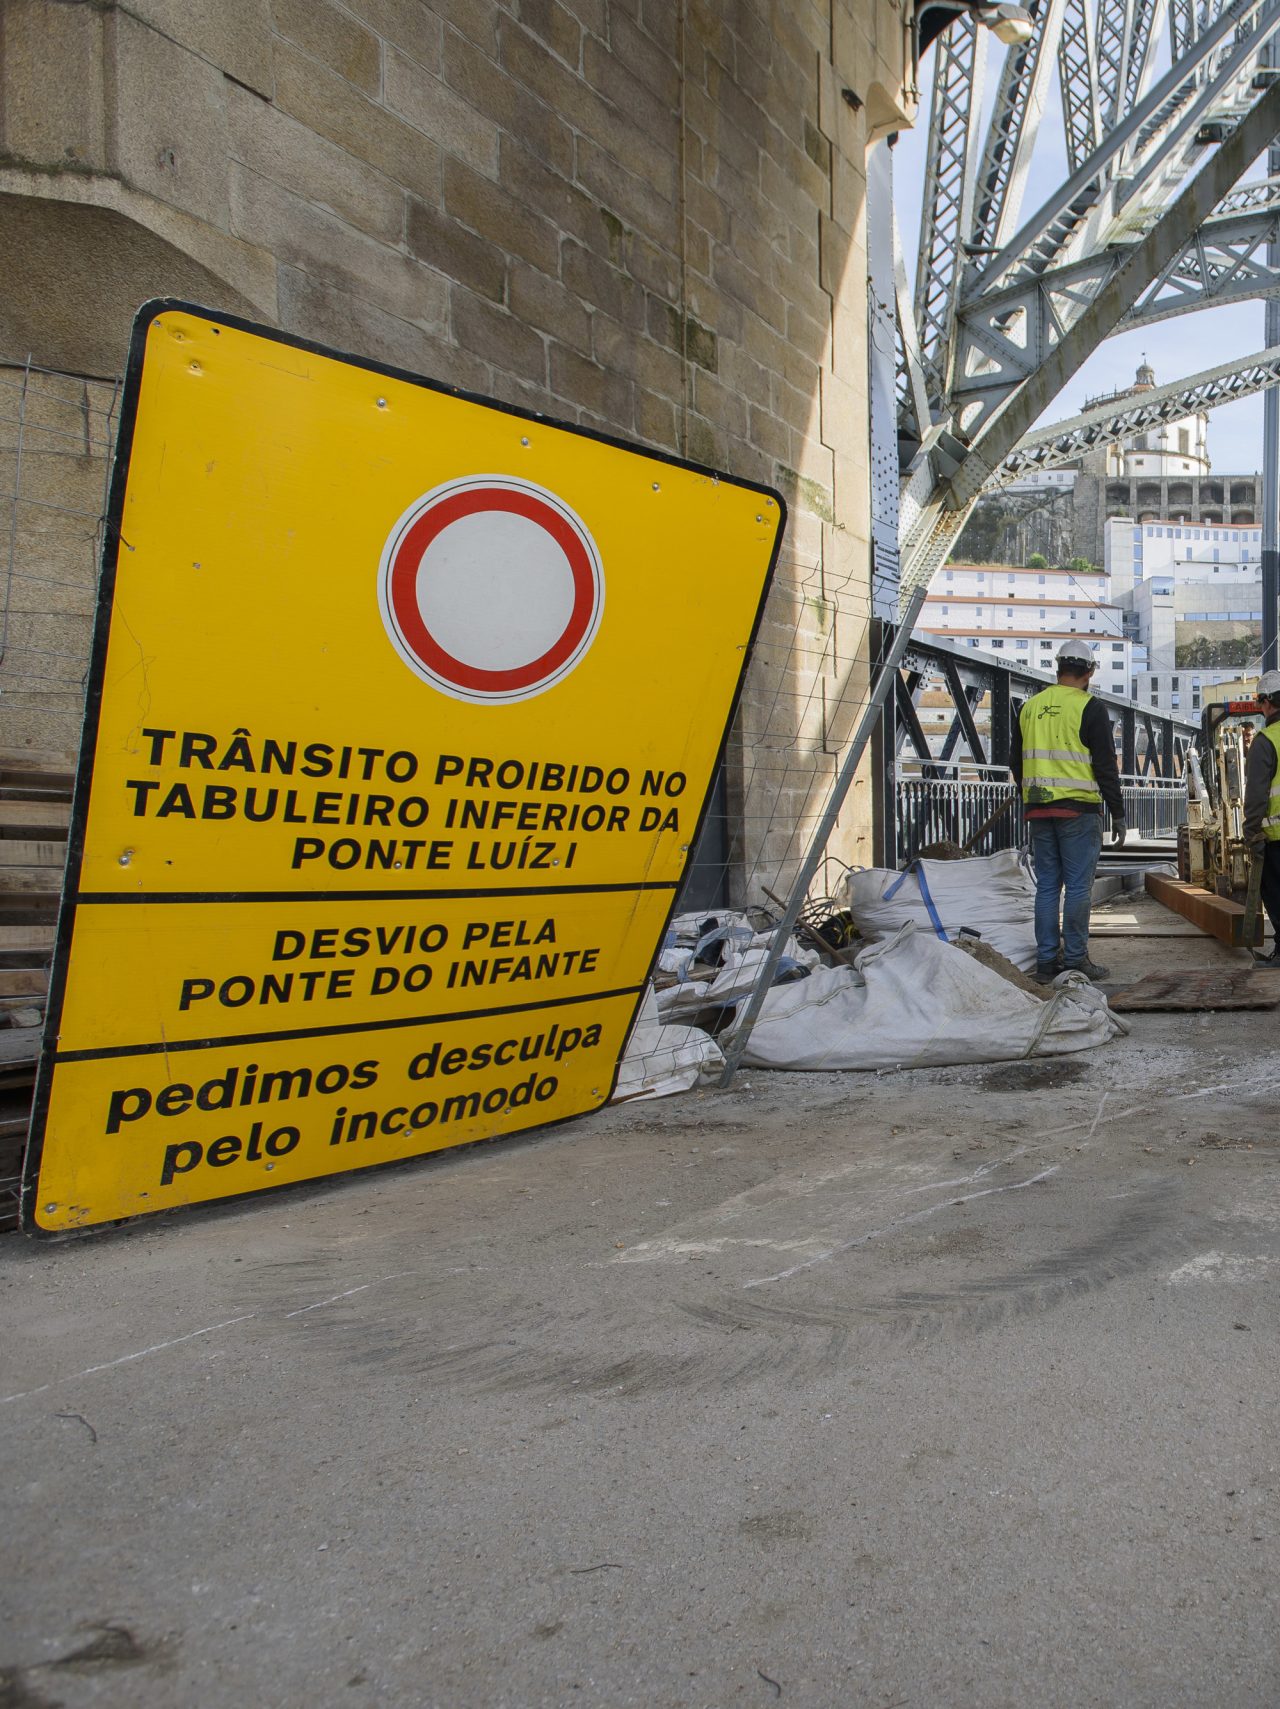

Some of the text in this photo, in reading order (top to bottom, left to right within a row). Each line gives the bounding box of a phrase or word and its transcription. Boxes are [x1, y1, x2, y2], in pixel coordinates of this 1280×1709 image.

[142, 728, 687, 798] TRÂNSITO PROIBIDO NO
[126, 780, 679, 834] TABULEIRO INFERIOR DA
[292, 834, 578, 870] PONTE LUÍZ I
[272, 918, 557, 961] DESVIO PELA
[178, 948, 601, 1011] PONTE DO INFANTE
[105, 1023, 603, 1135] pedimos desculpa
[159, 1071, 559, 1187] pelo incomodo
